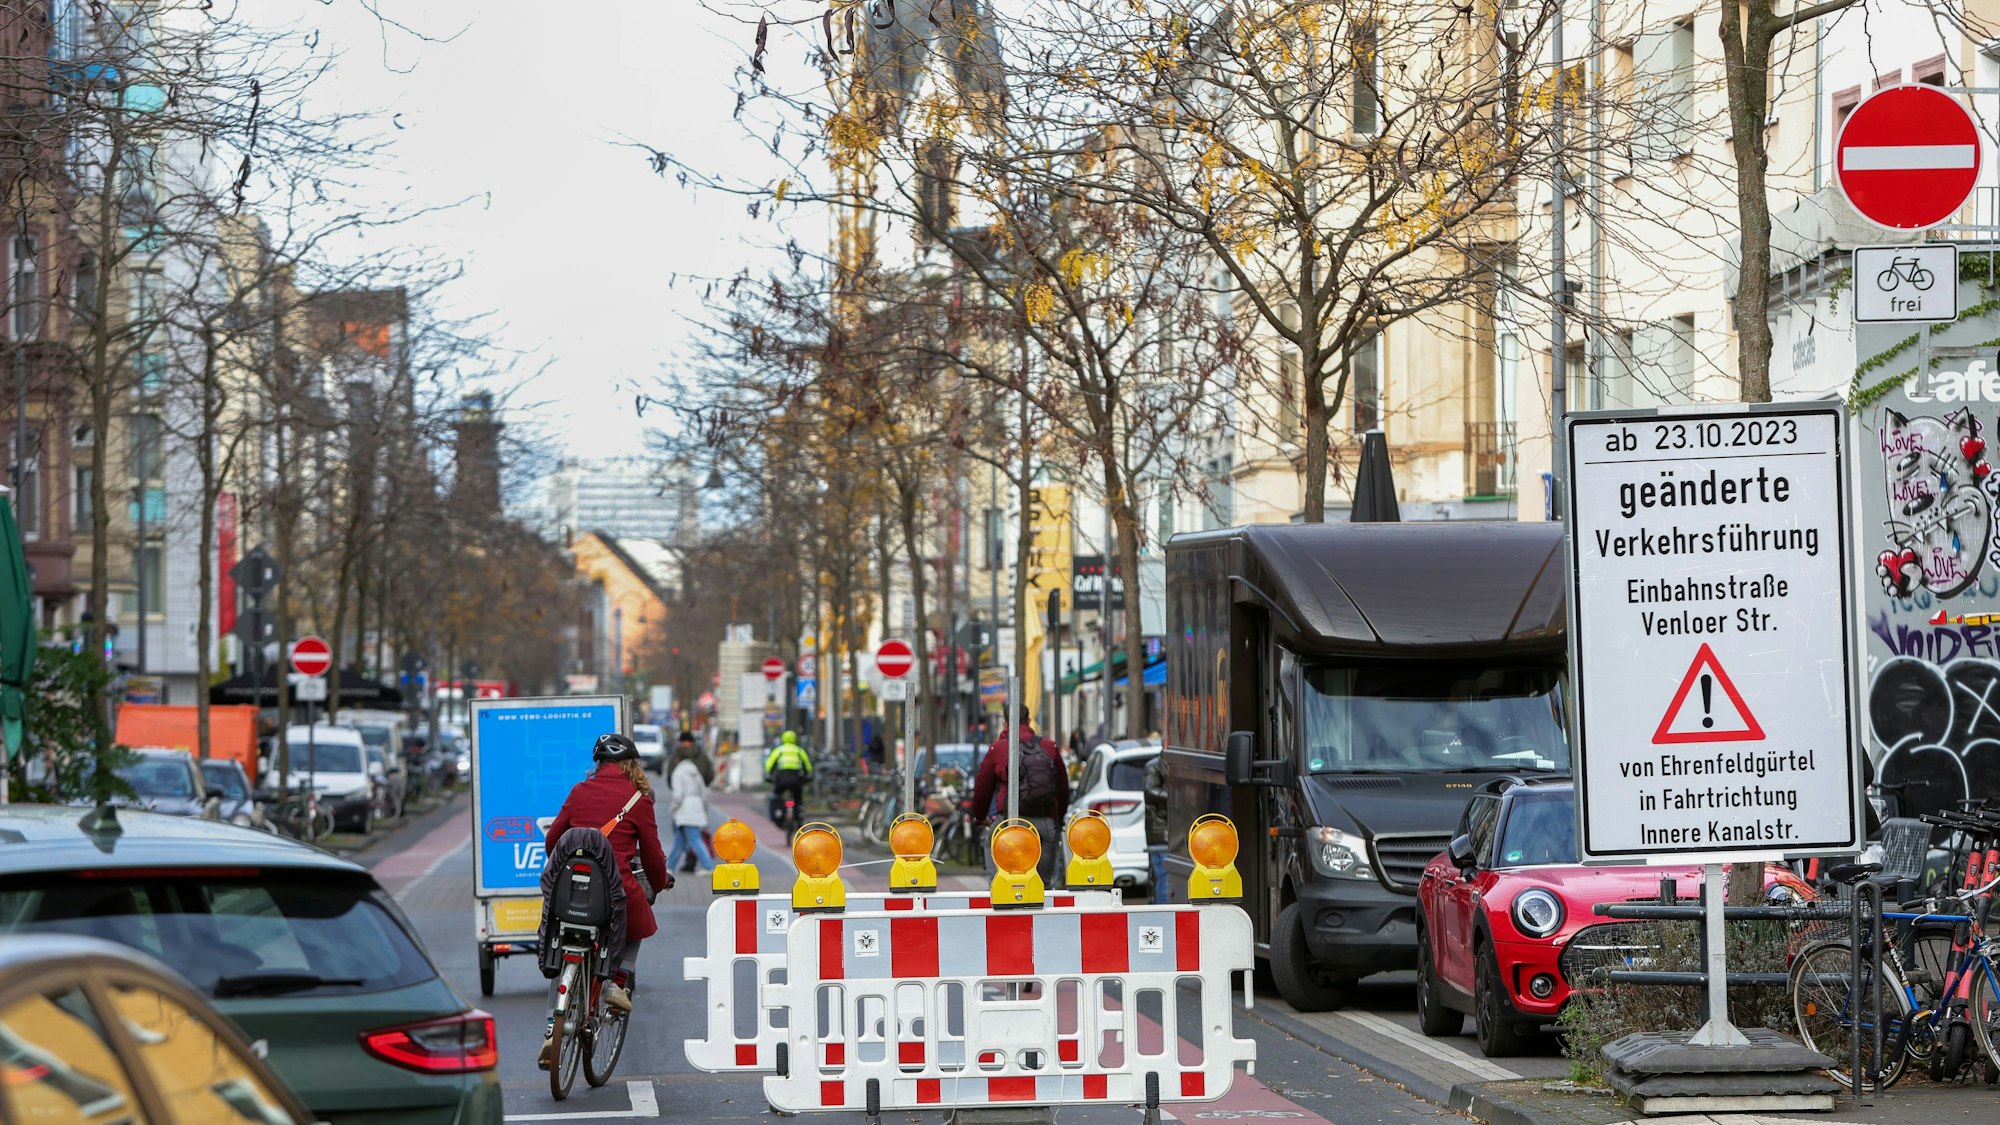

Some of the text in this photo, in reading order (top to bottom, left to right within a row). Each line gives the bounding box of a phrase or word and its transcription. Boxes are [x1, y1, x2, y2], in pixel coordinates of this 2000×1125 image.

[1891, 296, 1921, 312] frei
[1605, 419, 1798, 452] ab 23.10.2023
[1620, 467, 1790, 519] geänderte
[1595, 523, 1819, 557] Verkehrsführung
[1627, 573, 1788, 604] Einbahnstraße
[1641, 607, 1777, 636] Venloer Str.
[1619, 750, 1815, 779] von Ehrenfeldgürtel
[1639, 785, 1797, 811] in Fahrtrichtung
[1641, 818, 1799, 845] Innere Kanalstr.
